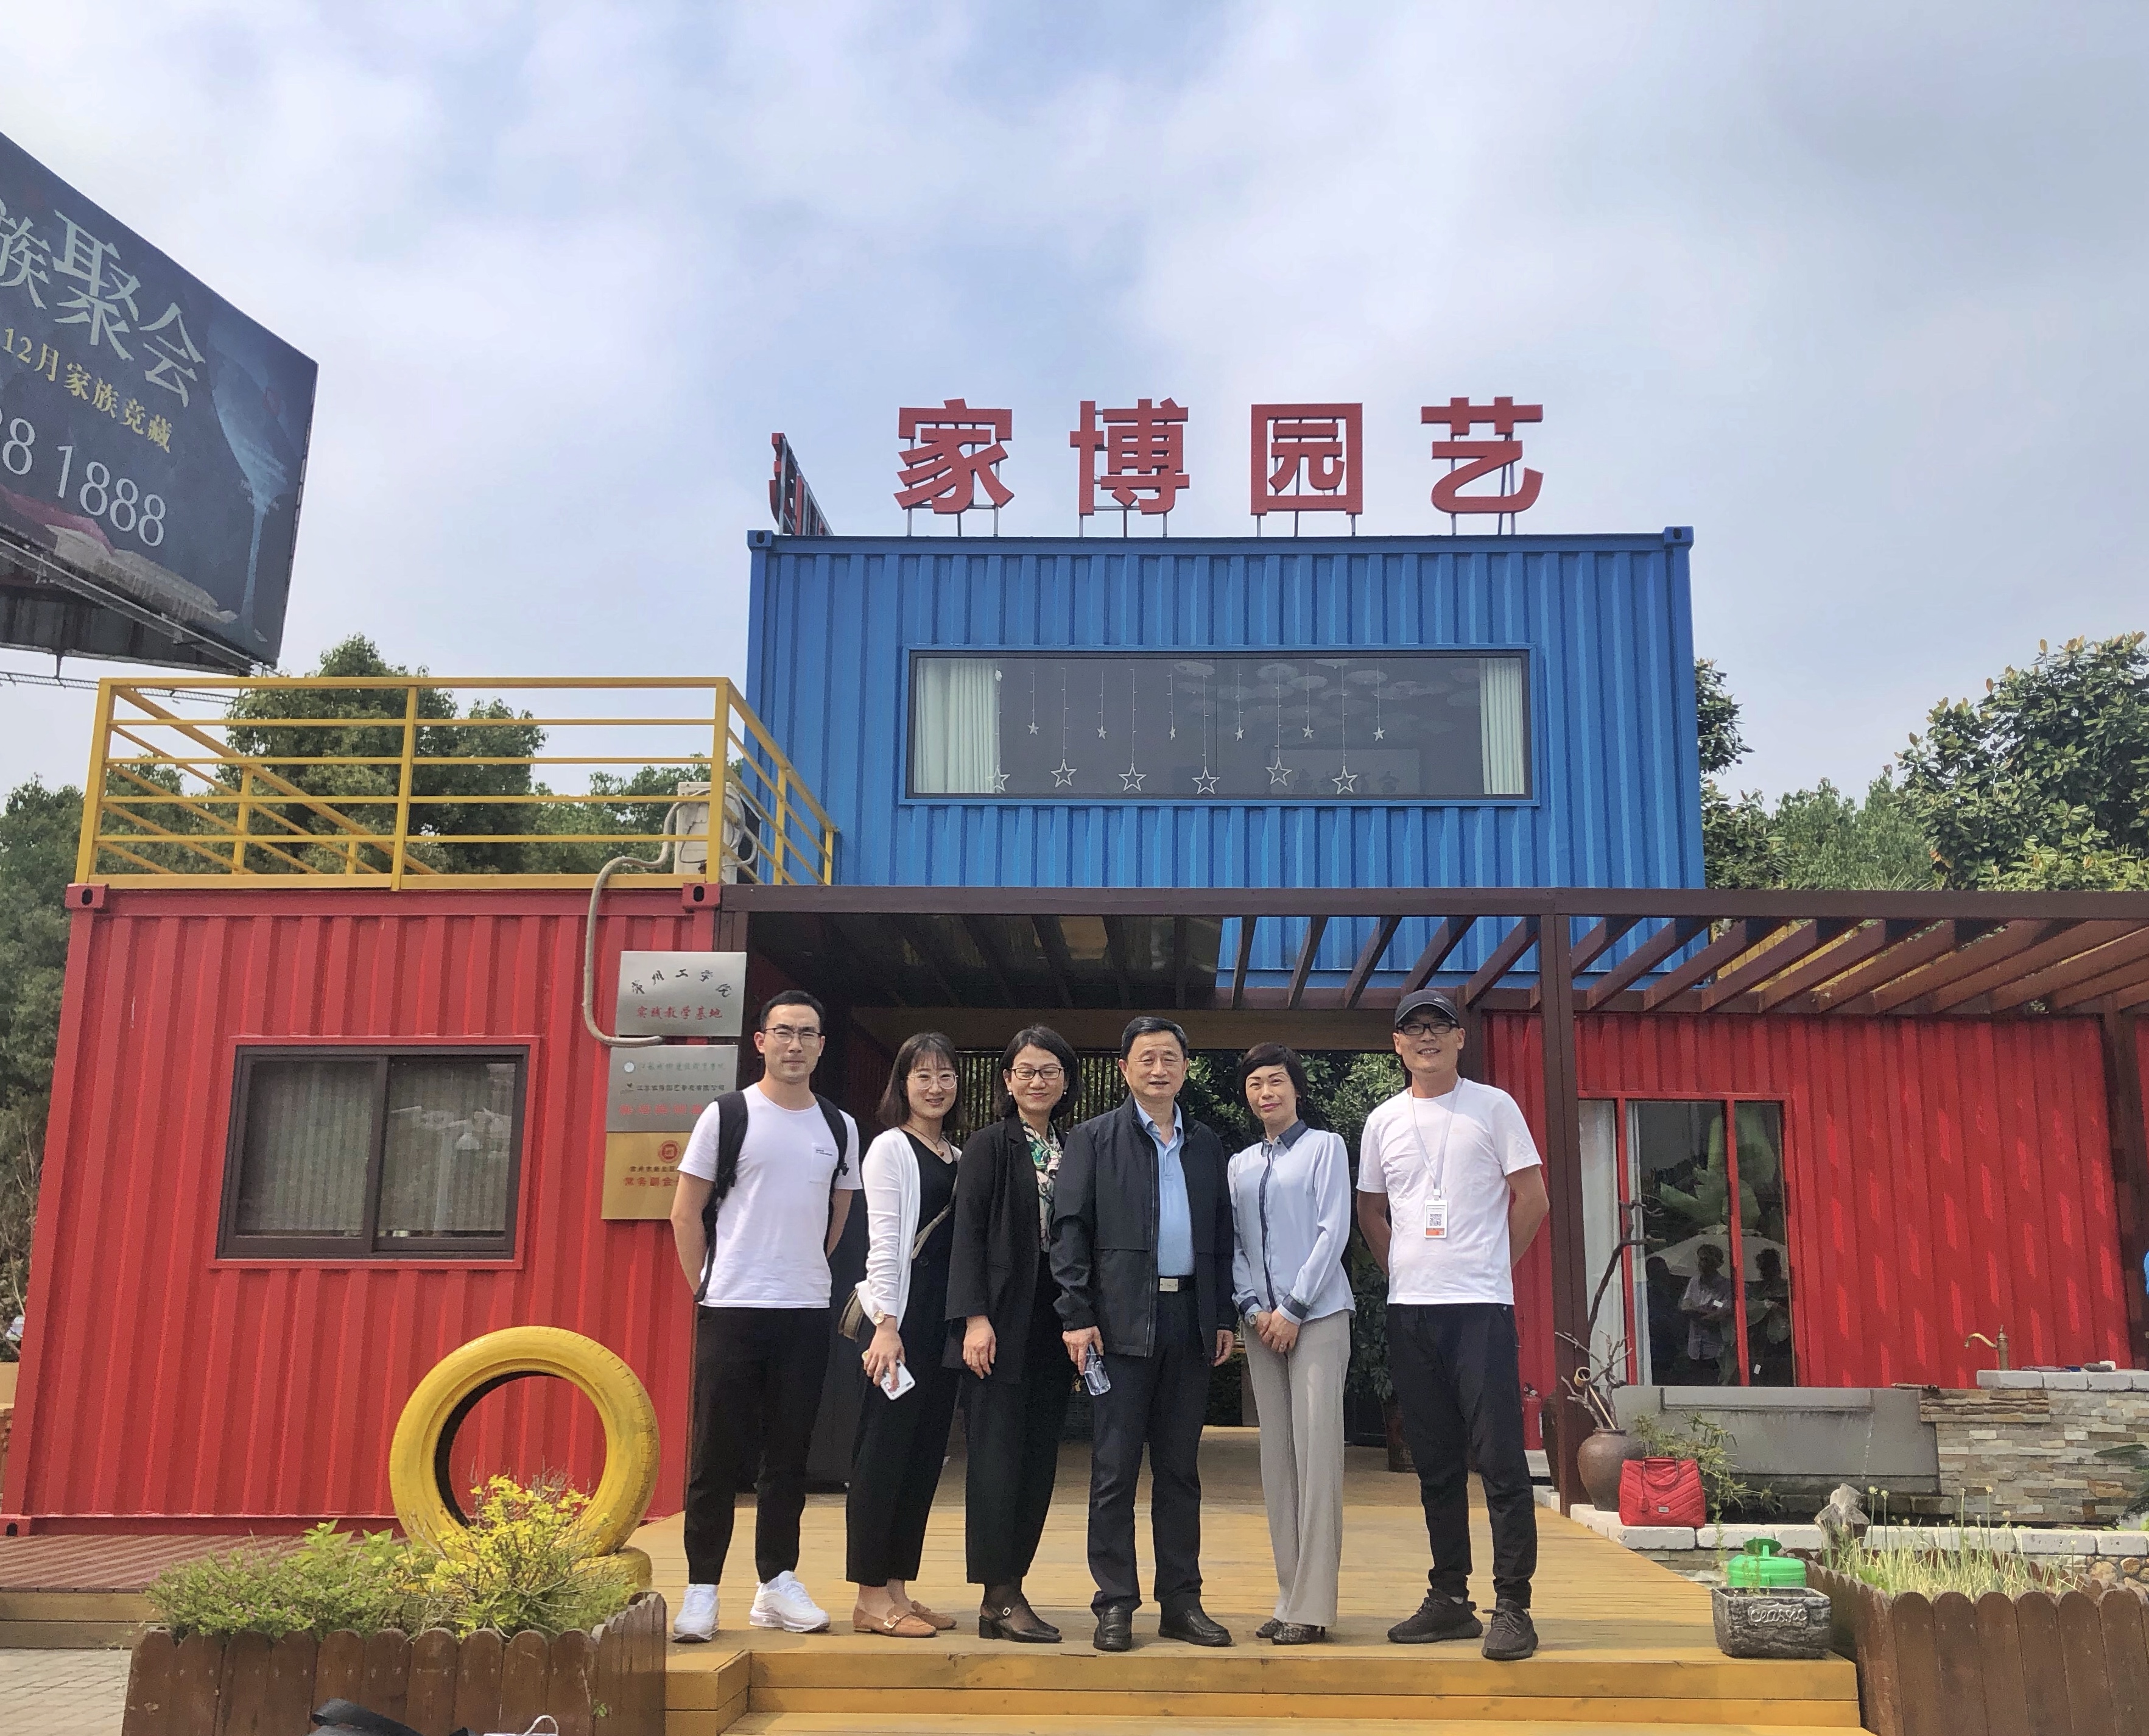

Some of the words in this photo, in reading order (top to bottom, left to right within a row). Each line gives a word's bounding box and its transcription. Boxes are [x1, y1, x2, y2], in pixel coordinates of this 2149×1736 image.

[893, 396, 1544, 516] 家博园艺
[57, 445, 166, 547] 1888
[636, 1005, 723, 1020] 实践教学基地
[624, 1176, 679, 1186] 常务副会
